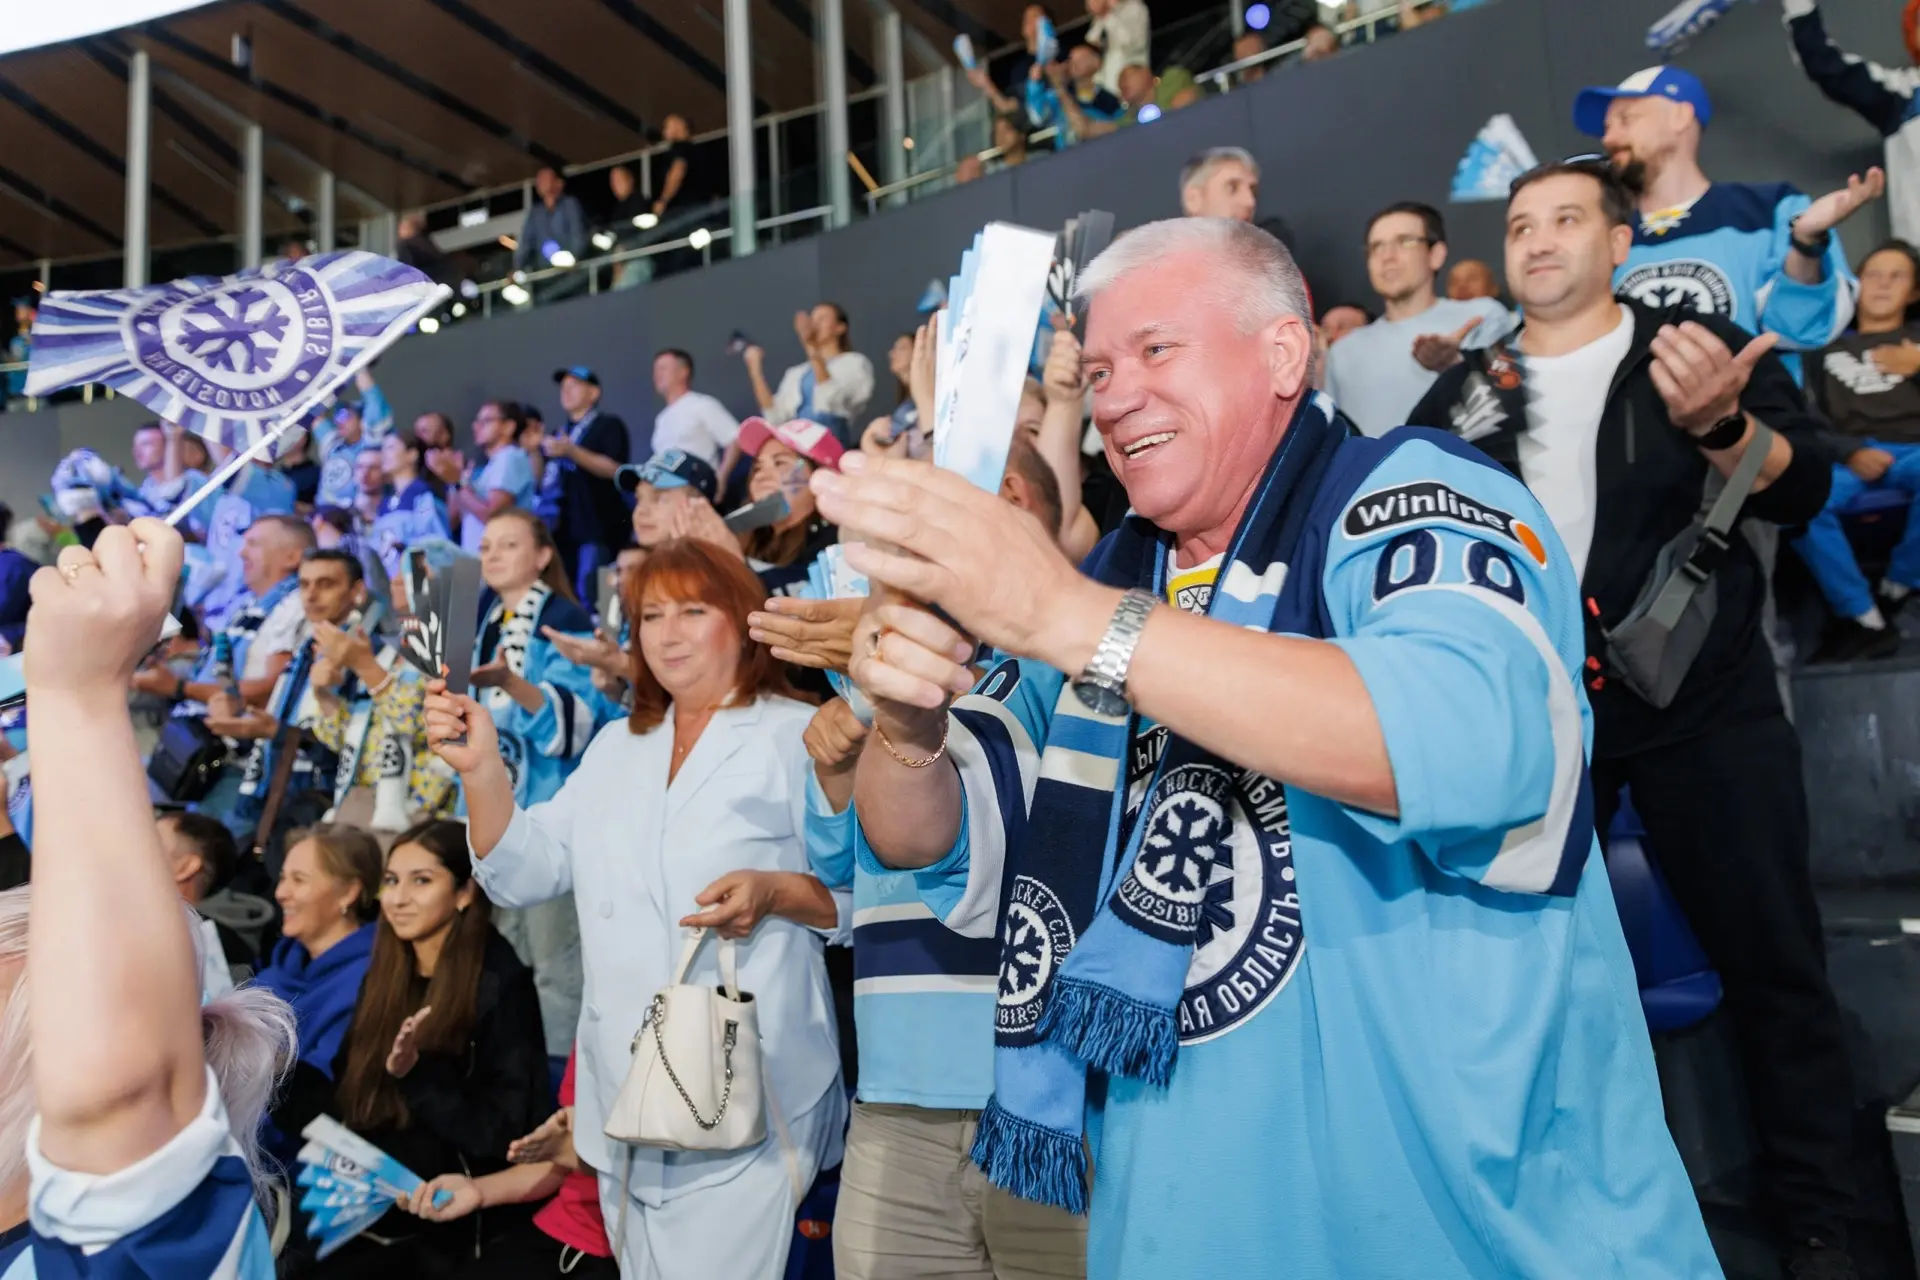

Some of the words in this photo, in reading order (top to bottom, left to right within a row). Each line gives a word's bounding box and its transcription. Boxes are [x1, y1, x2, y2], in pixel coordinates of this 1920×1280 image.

[1357, 489, 1505, 530] Winline
[1135, 728, 1168, 772] ЫЙ
[1166, 771, 1228, 801] HOCKE
[1238, 766, 1291, 858] ИБИРЬ
[1012, 883, 1056, 912] CKEY
[1179, 995, 1214, 1033] АЯ
[1218, 893, 1300, 1014] ОБЛАСТЬ
